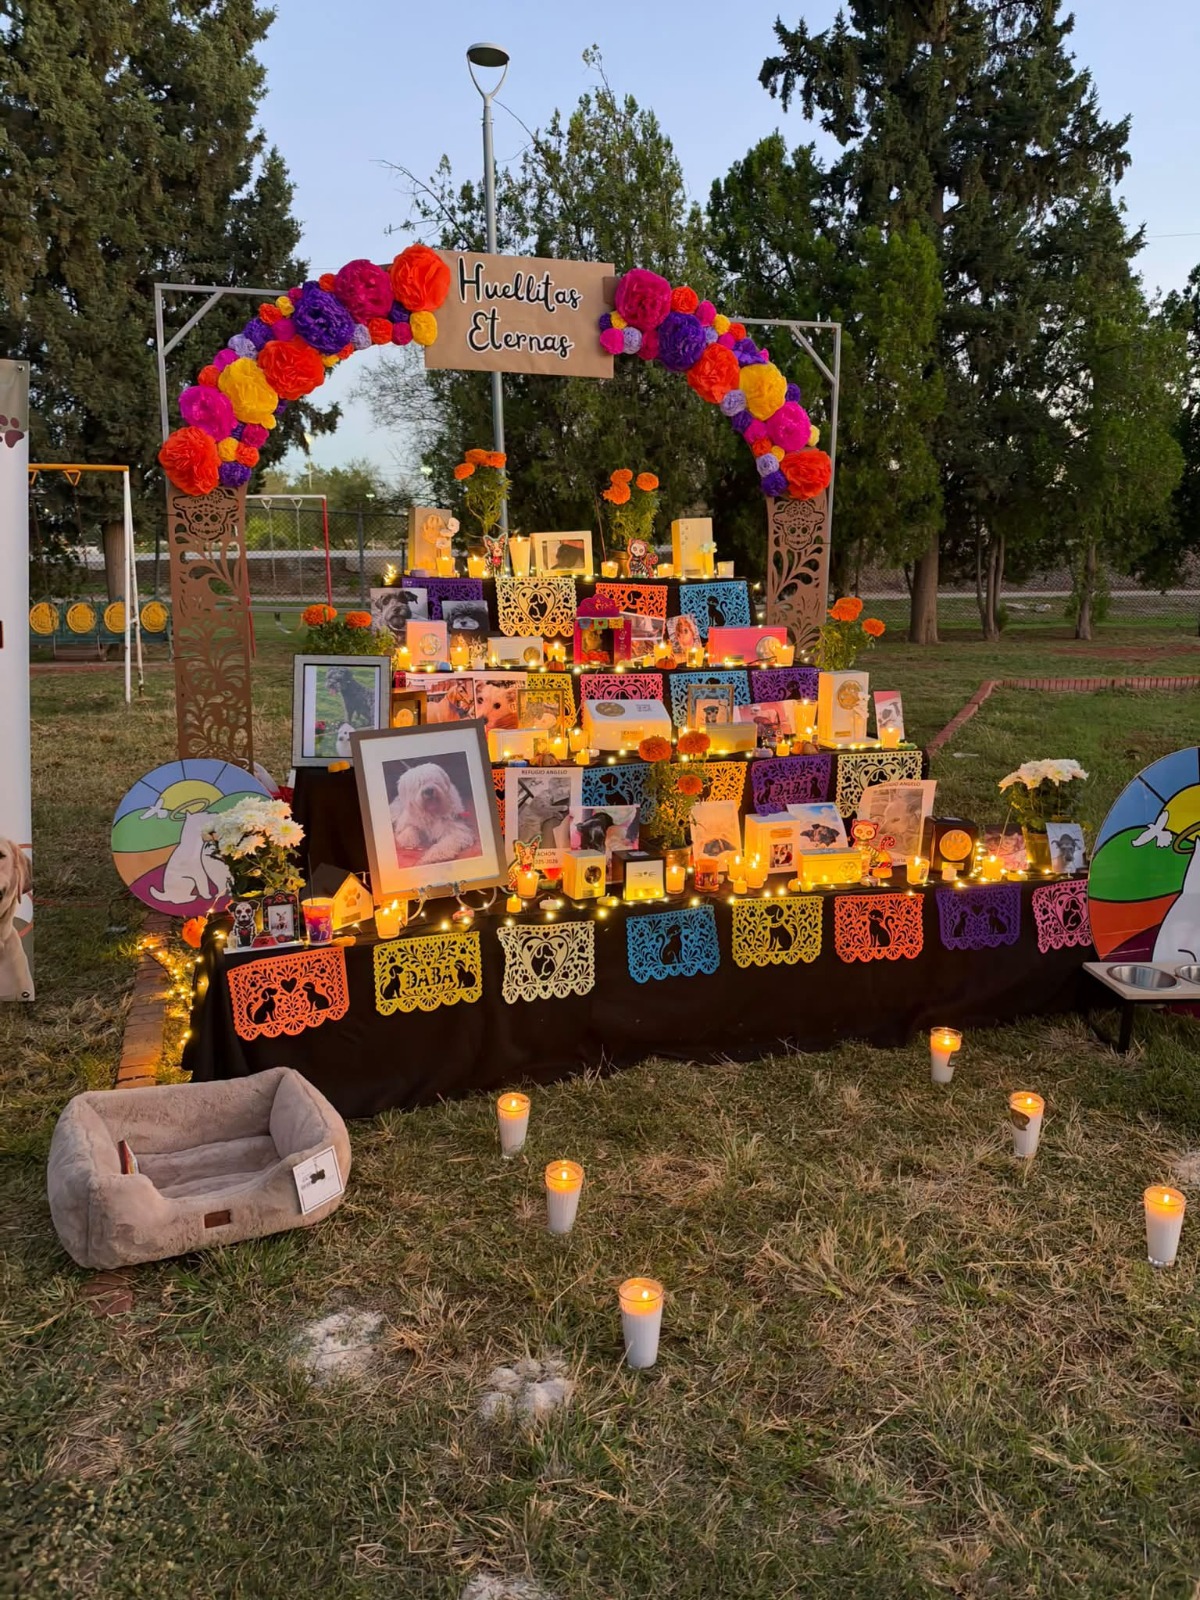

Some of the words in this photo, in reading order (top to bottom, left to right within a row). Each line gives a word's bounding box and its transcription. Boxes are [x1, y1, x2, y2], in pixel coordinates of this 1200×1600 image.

[458, 256, 582, 312] Huellitas
[467, 308, 575, 359] Eternas
[404, 965, 454, 990] DABA
